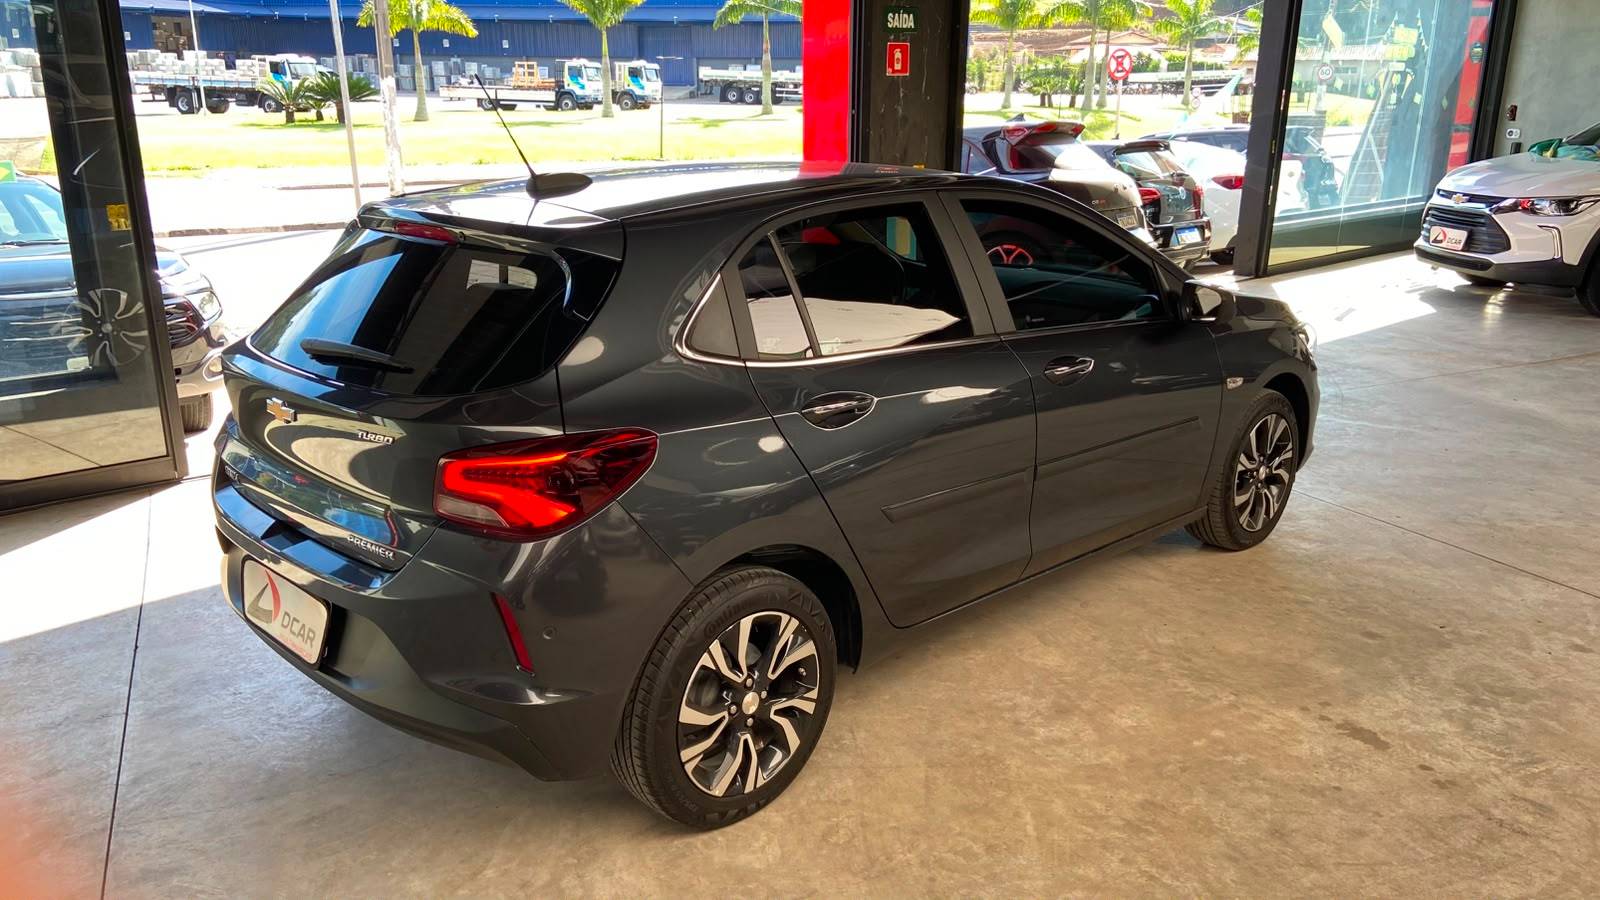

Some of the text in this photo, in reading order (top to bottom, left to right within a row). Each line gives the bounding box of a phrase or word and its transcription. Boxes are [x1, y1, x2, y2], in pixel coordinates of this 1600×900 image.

[887, 10, 915, 28] SAÍDA
[357, 431, 393, 445] TURBO
[347, 535, 395, 560] PREMIER
[280, 610, 317, 648] DCAR
